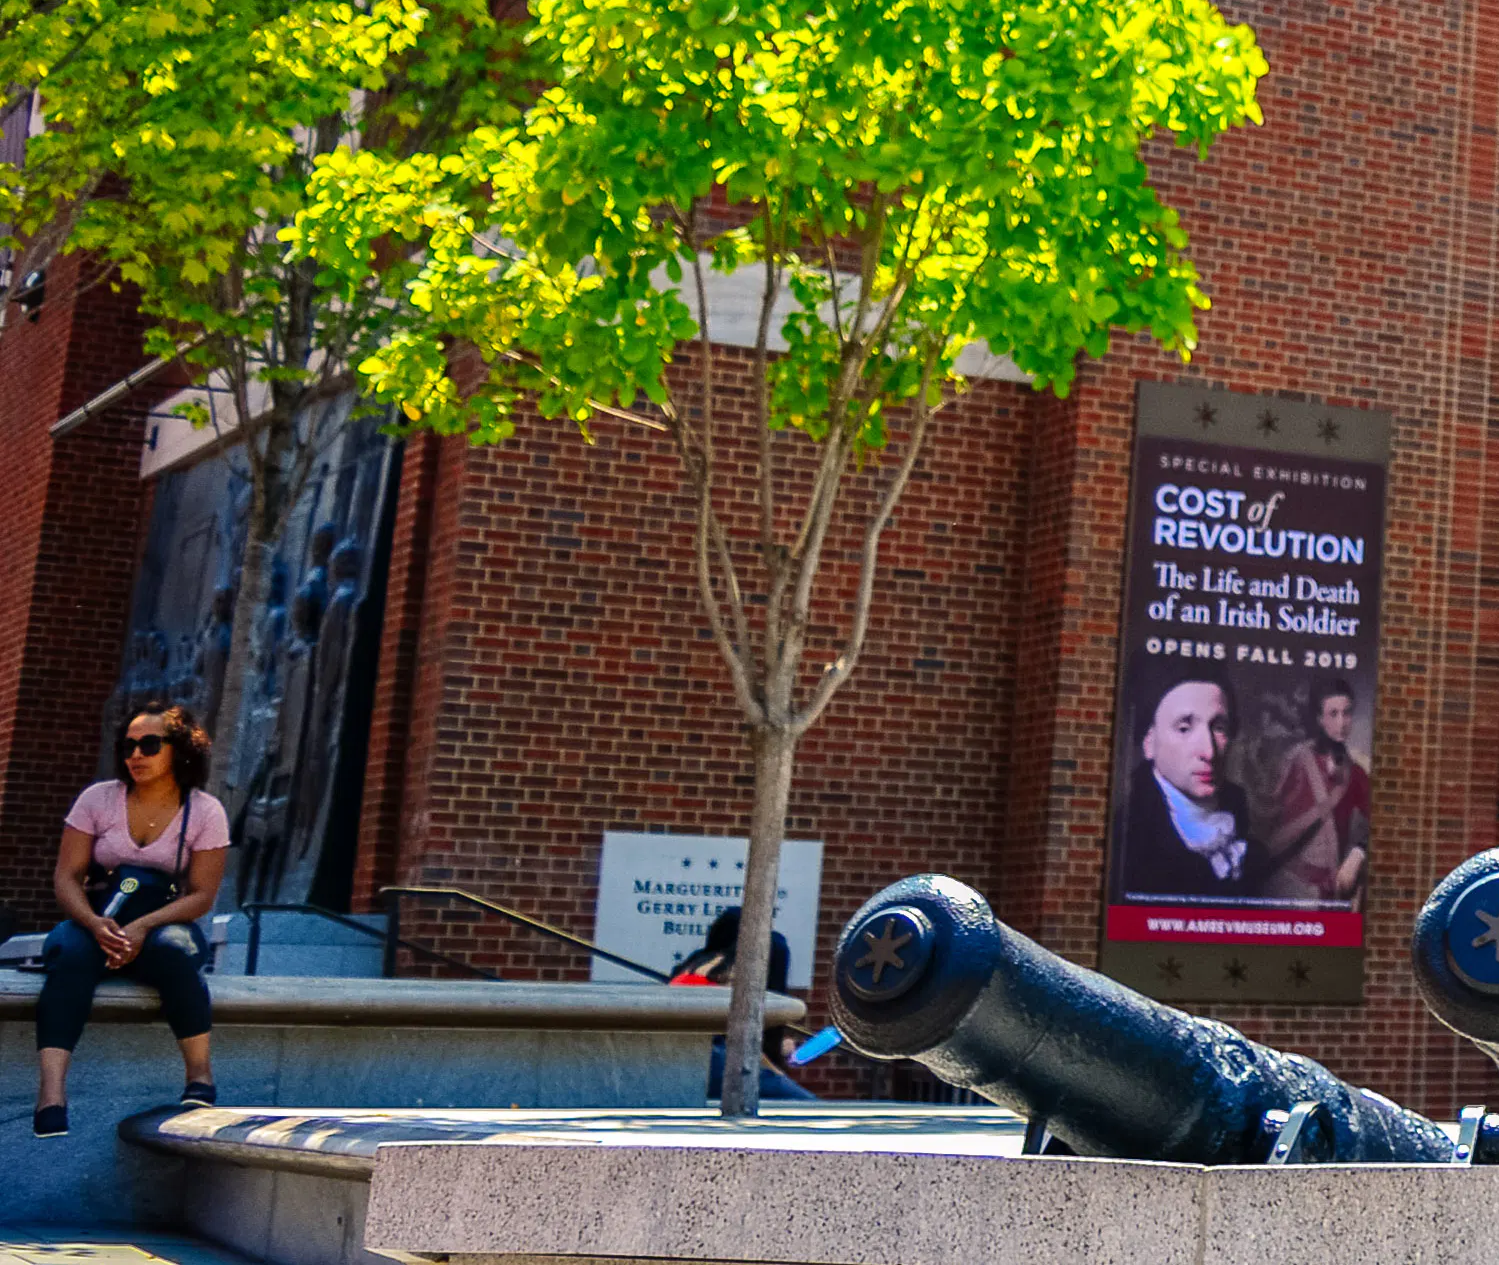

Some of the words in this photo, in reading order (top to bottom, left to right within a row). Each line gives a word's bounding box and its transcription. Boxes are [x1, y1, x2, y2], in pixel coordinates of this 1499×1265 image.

[1158, 453, 1244, 478] SPECIAL
[1252, 466, 1368, 491] EXHIBITION
[1155, 484, 1247, 521] COST
[1247, 490, 1286, 533] of
[1154, 516, 1365, 566] REVOLUTION
[1152, 560, 1198, 591] The
[1201, 565, 1246, 595] Life
[1249, 572, 1291, 600] and
[1295, 574, 1360, 606] Death
[1148, 591, 1182, 622] of
[1180, 604, 1211, 625] an
[1216, 598, 1272, 630] Irish
[1276, 602, 1361, 637] Soldier
[1146, 636, 1227, 661] OPENS
[1236, 643, 1295, 666] FALL
[1303, 649, 1359, 670] 2019
[632, 879, 743, 898] MARGUERIT
[636, 900, 699, 916] GERRY
[662, 920, 712, 936] BUIL
